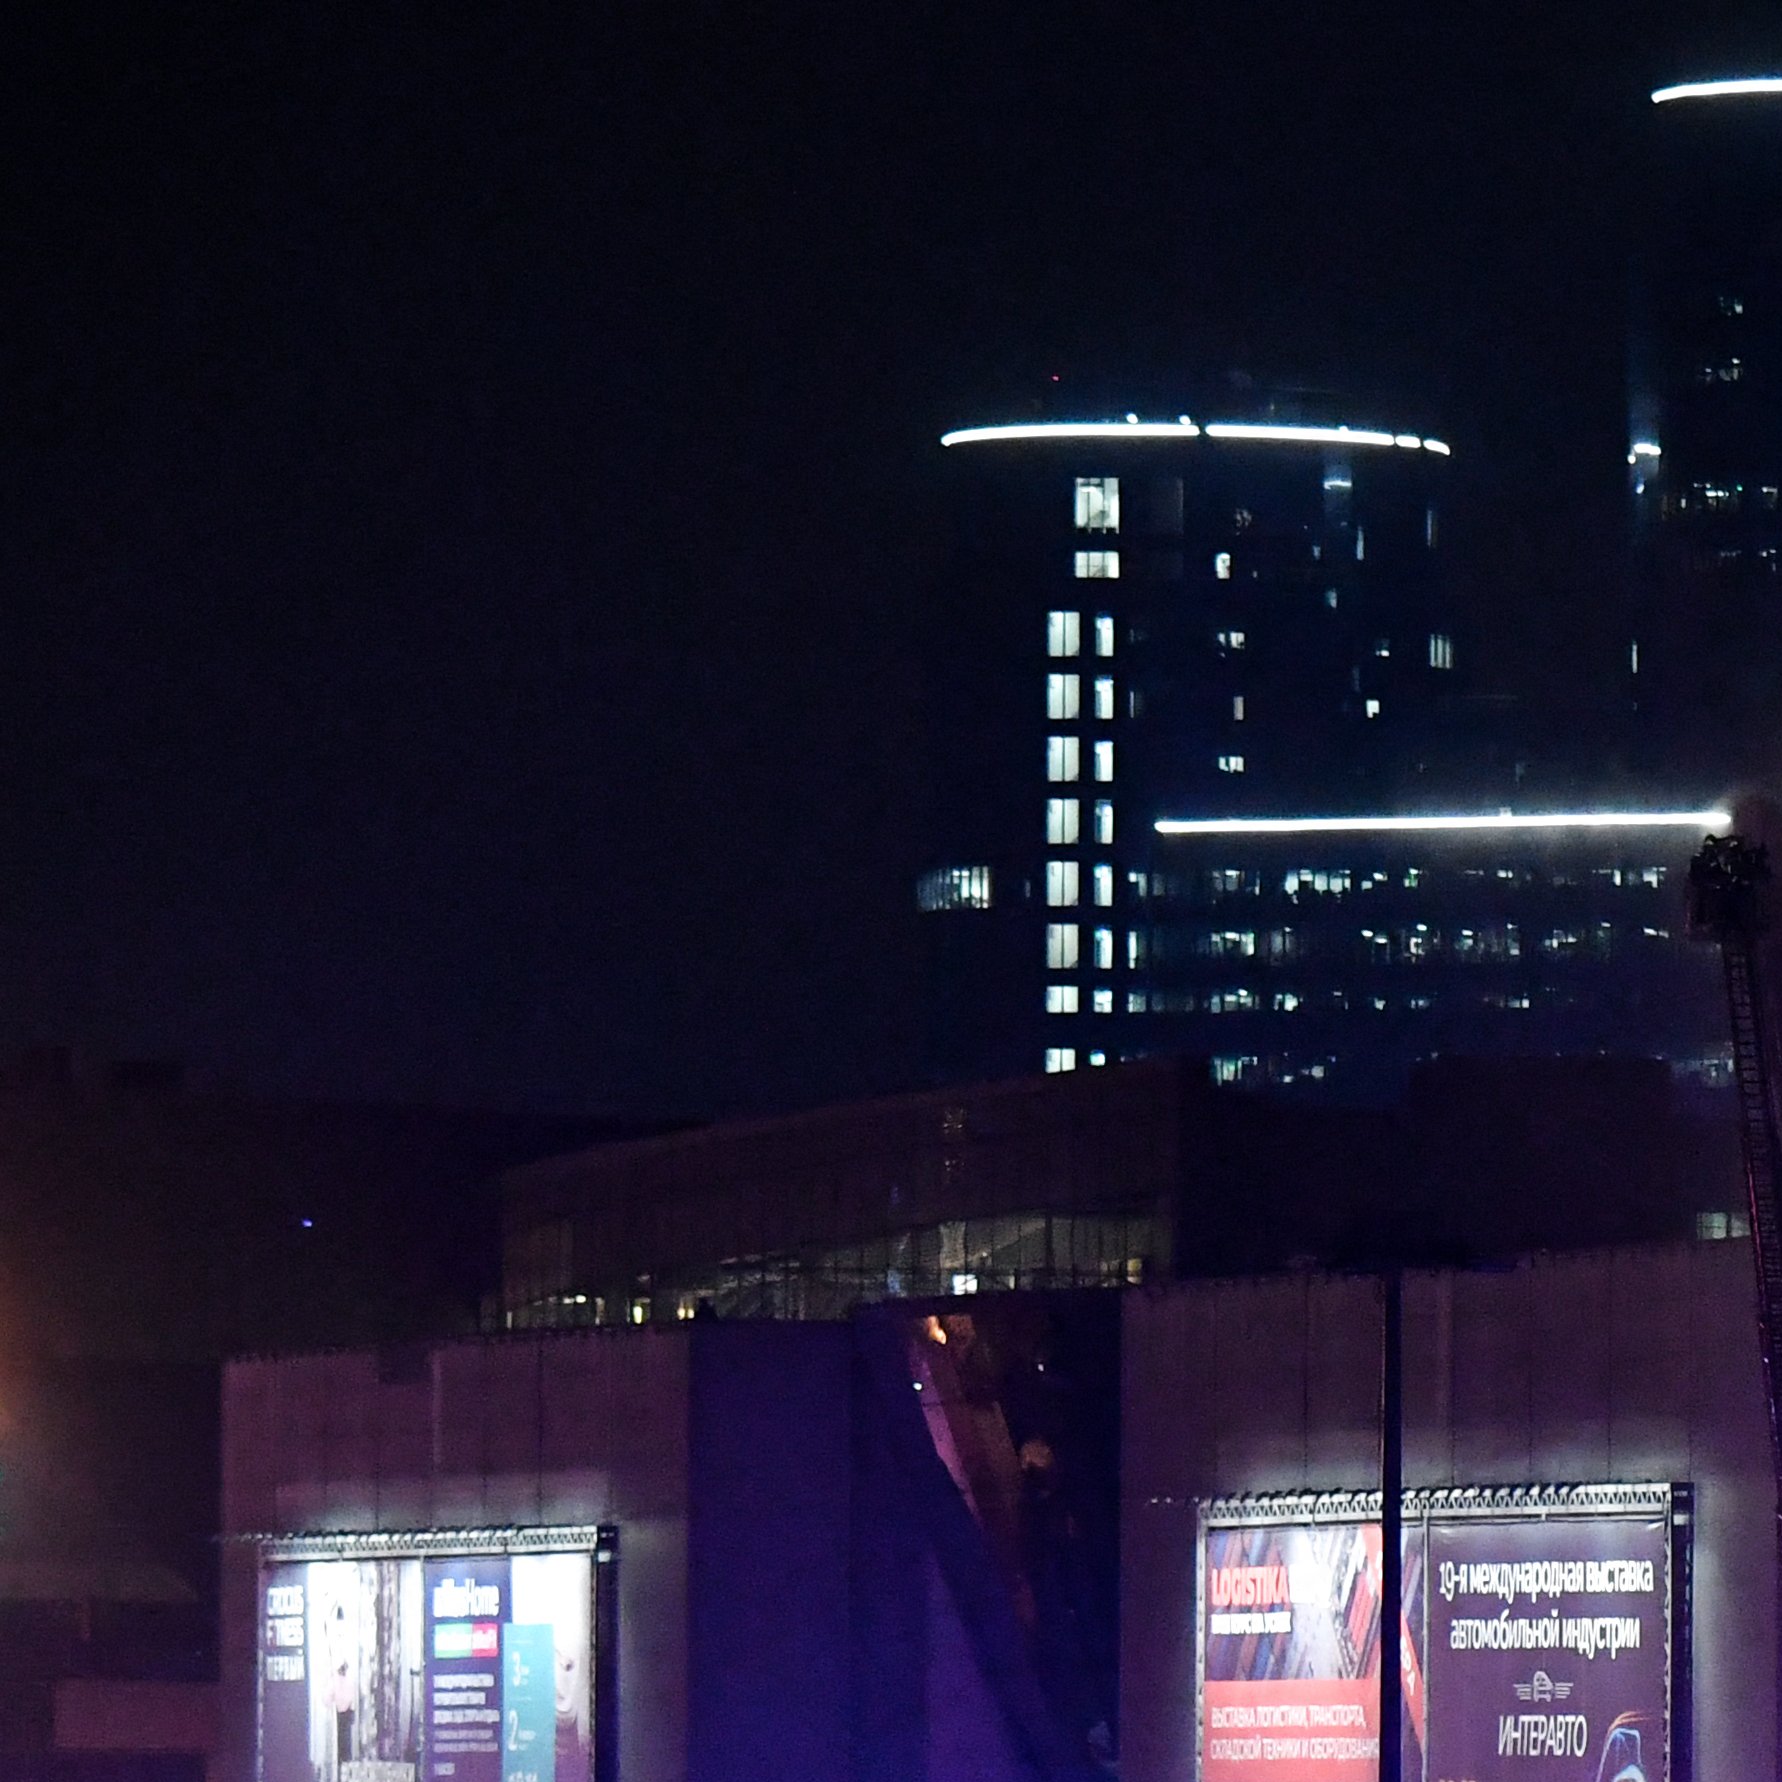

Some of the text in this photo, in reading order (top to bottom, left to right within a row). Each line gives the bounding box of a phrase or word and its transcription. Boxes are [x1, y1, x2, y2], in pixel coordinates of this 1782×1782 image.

[1211, 1565, 1290, 1606] LOGISTIKA
[1439, 1560, 1654, 1604] 19-я международная выставка
[1450, 1608, 1641, 1660] автомобильной индустрии
[1498, 1714, 1588, 1757] ИНТЕРАВТО
